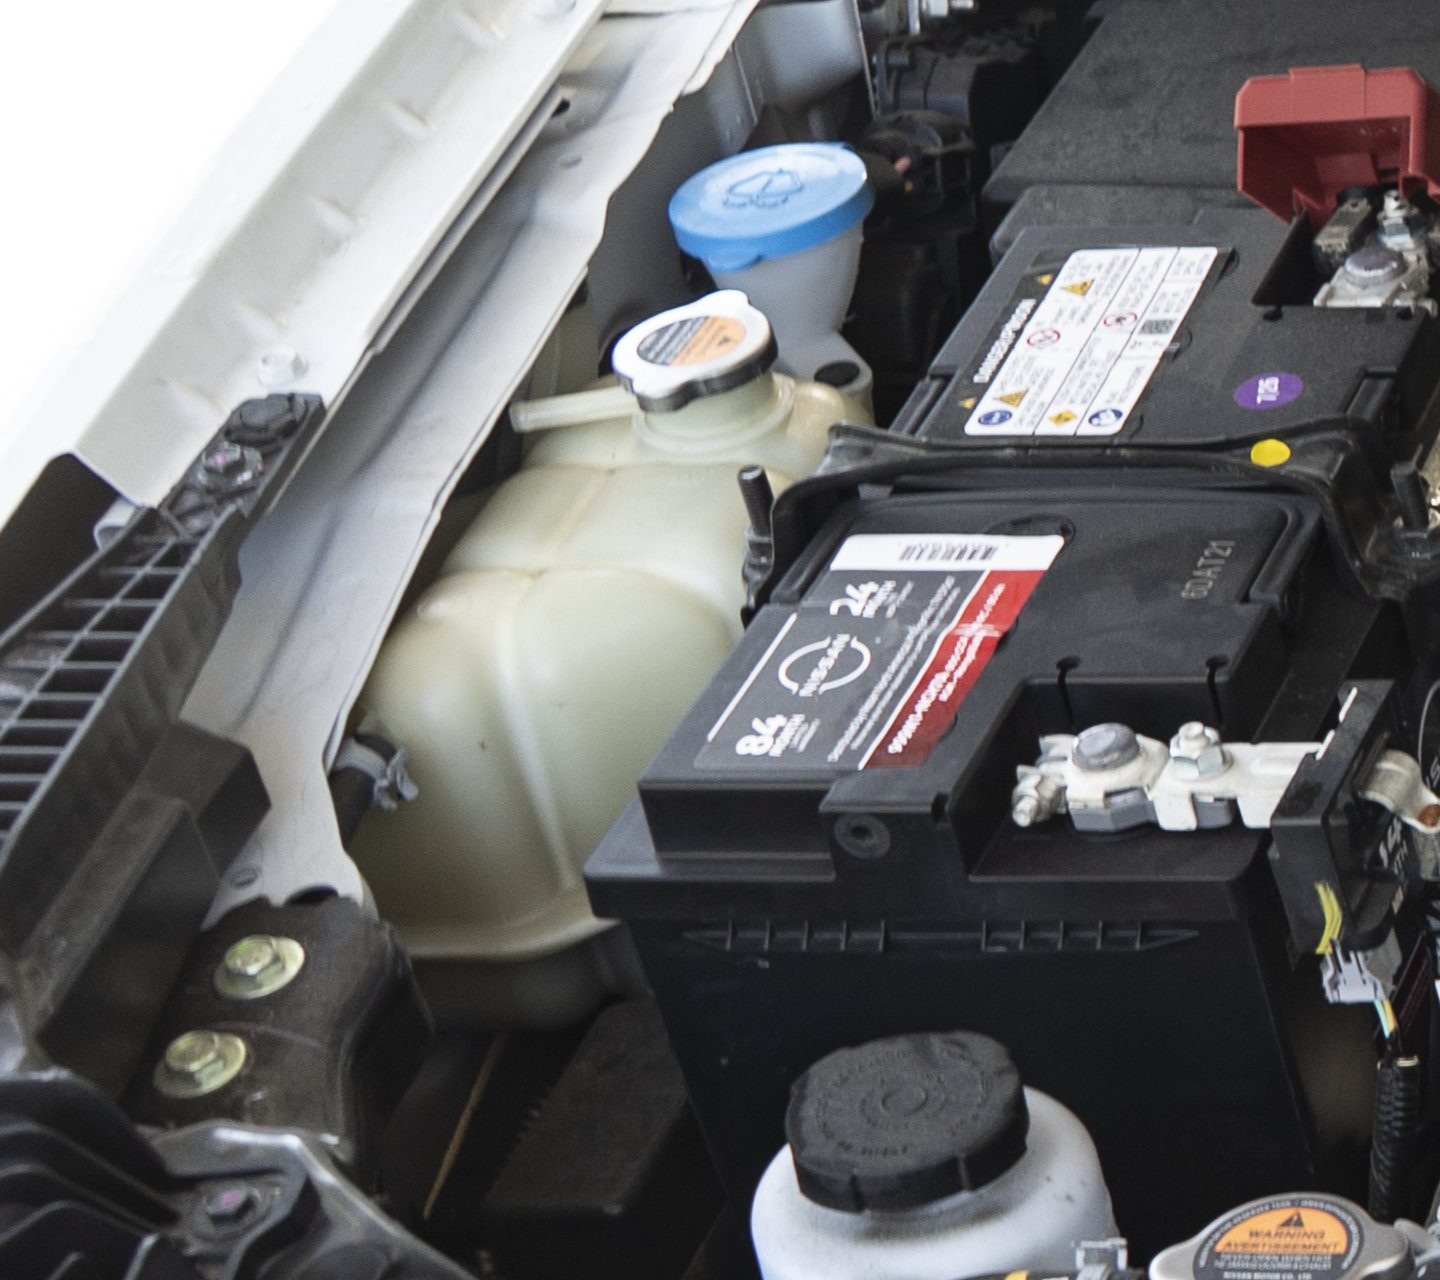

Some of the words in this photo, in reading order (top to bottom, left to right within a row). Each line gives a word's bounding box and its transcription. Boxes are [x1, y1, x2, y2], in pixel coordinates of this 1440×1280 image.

[829, 580, 880, 617] 24
[798, 632, 852, 698] NISSAN
[734, 713, 788, 757] 84
[1224, 1241, 1340, 1251] AVERTISSEMENT
[1249, 1229, 1327, 1240] WARNING
